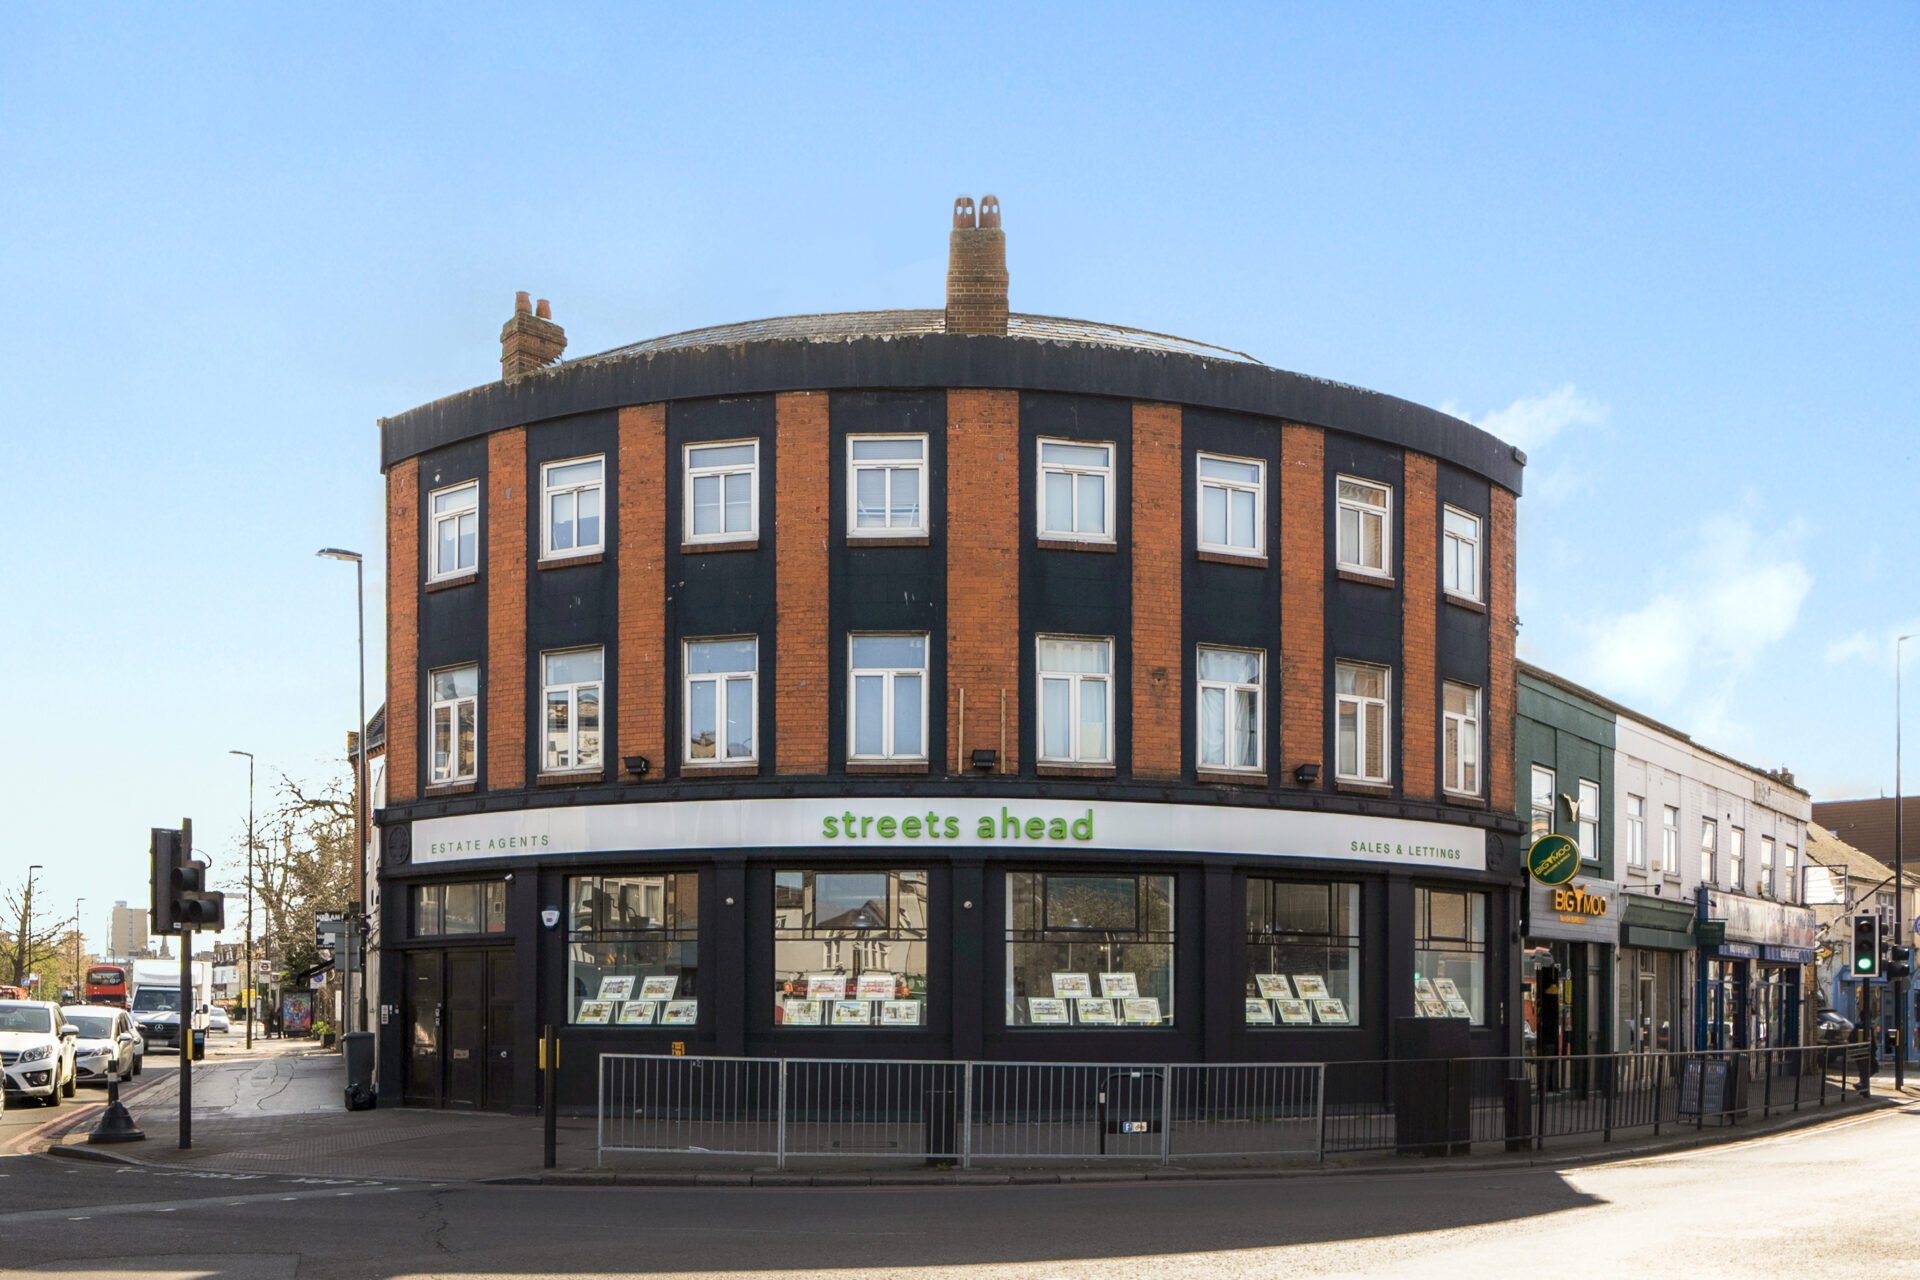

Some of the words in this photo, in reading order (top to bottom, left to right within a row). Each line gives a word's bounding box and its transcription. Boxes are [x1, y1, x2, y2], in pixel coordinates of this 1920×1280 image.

[822, 811, 960, 839] streets
[977, 806, 1093, 840] ahead
[431, 840, 481, 854] ESTATE
[488, 835, 549, 849] AGENTS
[1351, 841, 1391, 855] SALES
[1396, 844, 1403, 855] &
[1408, 845, 1461, 860] LETTINGS
